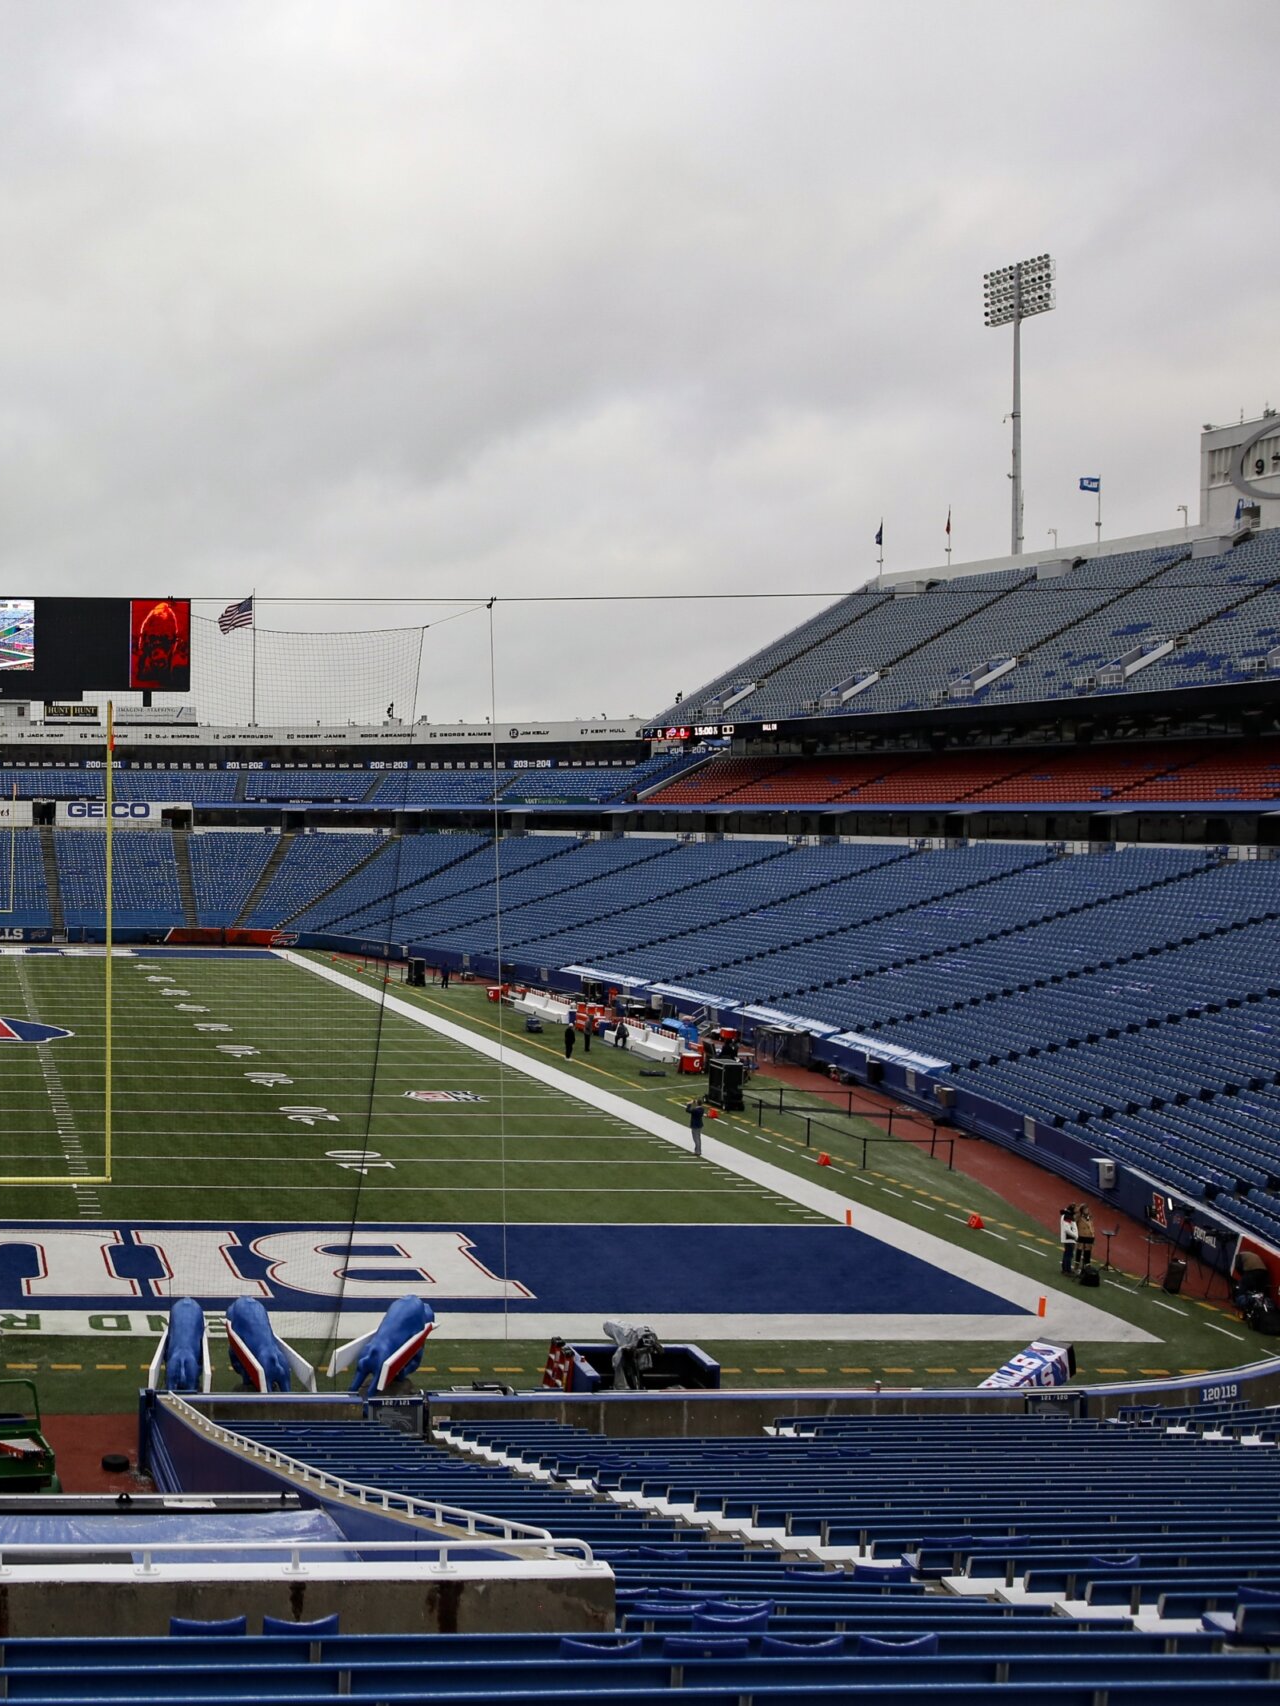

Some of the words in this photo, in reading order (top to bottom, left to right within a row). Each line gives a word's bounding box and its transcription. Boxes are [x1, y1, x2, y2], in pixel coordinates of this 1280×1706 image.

[1255, 459, 1264, 475] 9
[47, 706, 69, 714] HUNT
[74, 706, 97, 714] HUNT
[657, 729, 662, 738] 0
[679, 728, 685, 736] 0
[694, 726, 714, 736] 15:00
[226, 761, 240, 769] 201
[248, 761, 263, 769] 202
[370, 761, 385, 769] 202
[393, 761, 408, 769] 203
[513, 760, 528, 768] 203
[536, 760, 551, 768] 204
[693, 1059, 700, 1068] G
[278, 1105, 341, 1124] 20
[324, 1149, 397, 1172] 10
[1202, 1388, 1221, 1401] 120
[1221, 1385, 1237, 1398] 119
